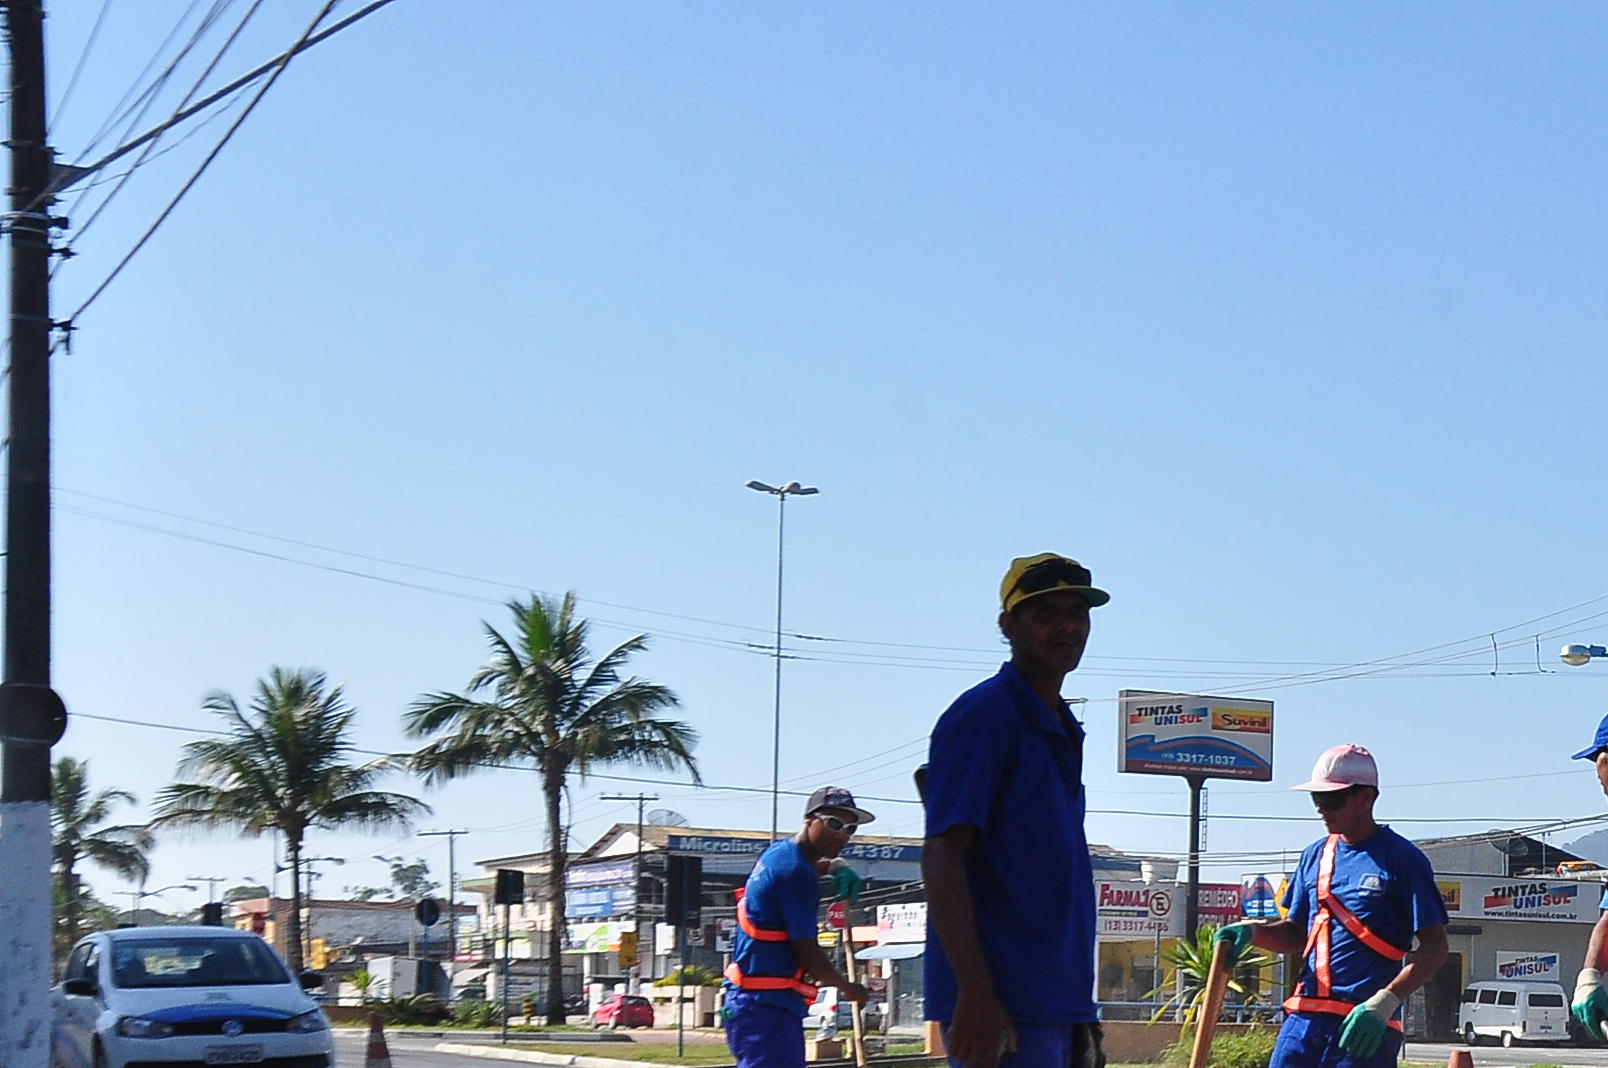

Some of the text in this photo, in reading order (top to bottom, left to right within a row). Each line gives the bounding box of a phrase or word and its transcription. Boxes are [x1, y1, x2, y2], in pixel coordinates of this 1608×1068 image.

[1136, 705, 1183, 717] TINTAS
[1154, 714, 1203, 726] UNISUL
[1221, 713, 1267, 728] Suvinil
[1176, 752, 1236, 765] 3317-1037
[1492, 882, 1548, 898] TINTAS
[1513, 895, 1572, 910] UNISUL
[829, 910, 846, 919] PAR
[1484, 910, 1577, 920] www.tintasunisul.com.br
[1514, 955, 1538, 965] TINTAS
[1504, 963, 1550, 978] UNISUL
